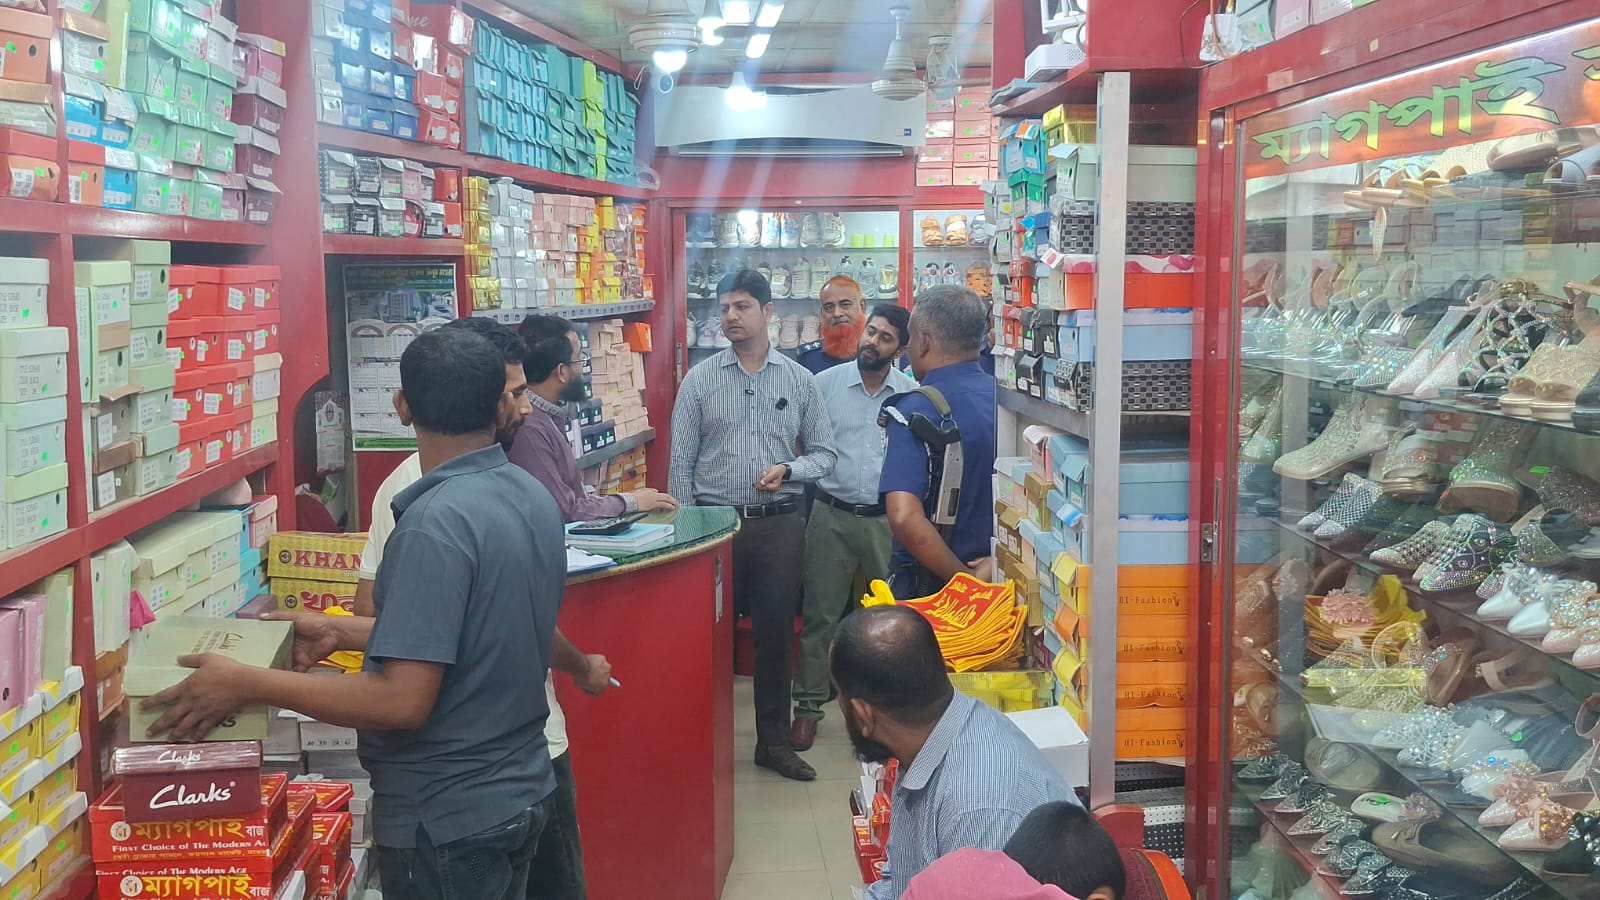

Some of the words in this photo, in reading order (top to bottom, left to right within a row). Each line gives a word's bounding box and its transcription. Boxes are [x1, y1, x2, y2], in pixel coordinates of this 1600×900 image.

[1251, 57, 1566, 165] ম্যাগপাই
[157, 750, 200, 764] Clarks
[149, 782, 231, 809] Clarks
